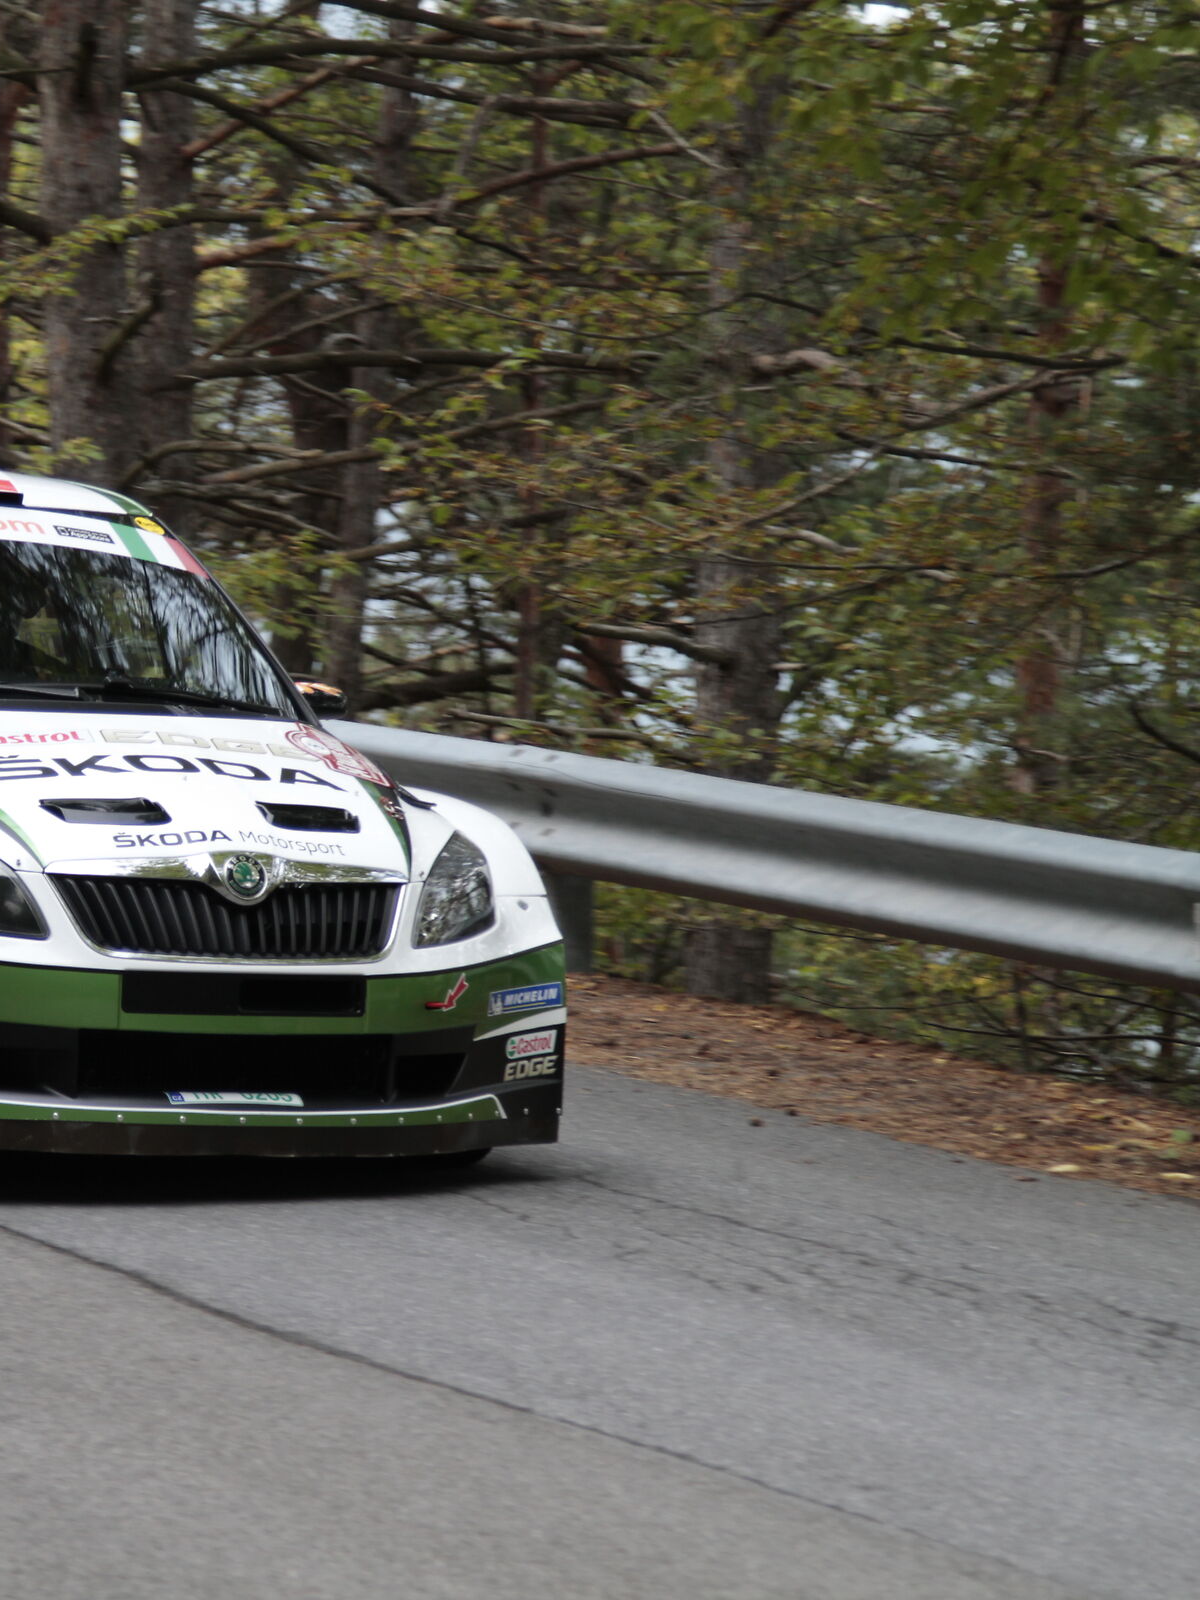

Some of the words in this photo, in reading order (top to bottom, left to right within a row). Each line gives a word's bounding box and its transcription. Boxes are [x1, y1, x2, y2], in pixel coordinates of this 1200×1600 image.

[100, 729, 321, 762] EDGE
[112, 830, 233, 848] ŠKODA
[239, 831, 345, 856] Motorsport
[504, 987, 559, 1006] MICHELIN
[516, 1033, 553, 1055] Castrol
[503, 1055, 559, 1083] EDGE
